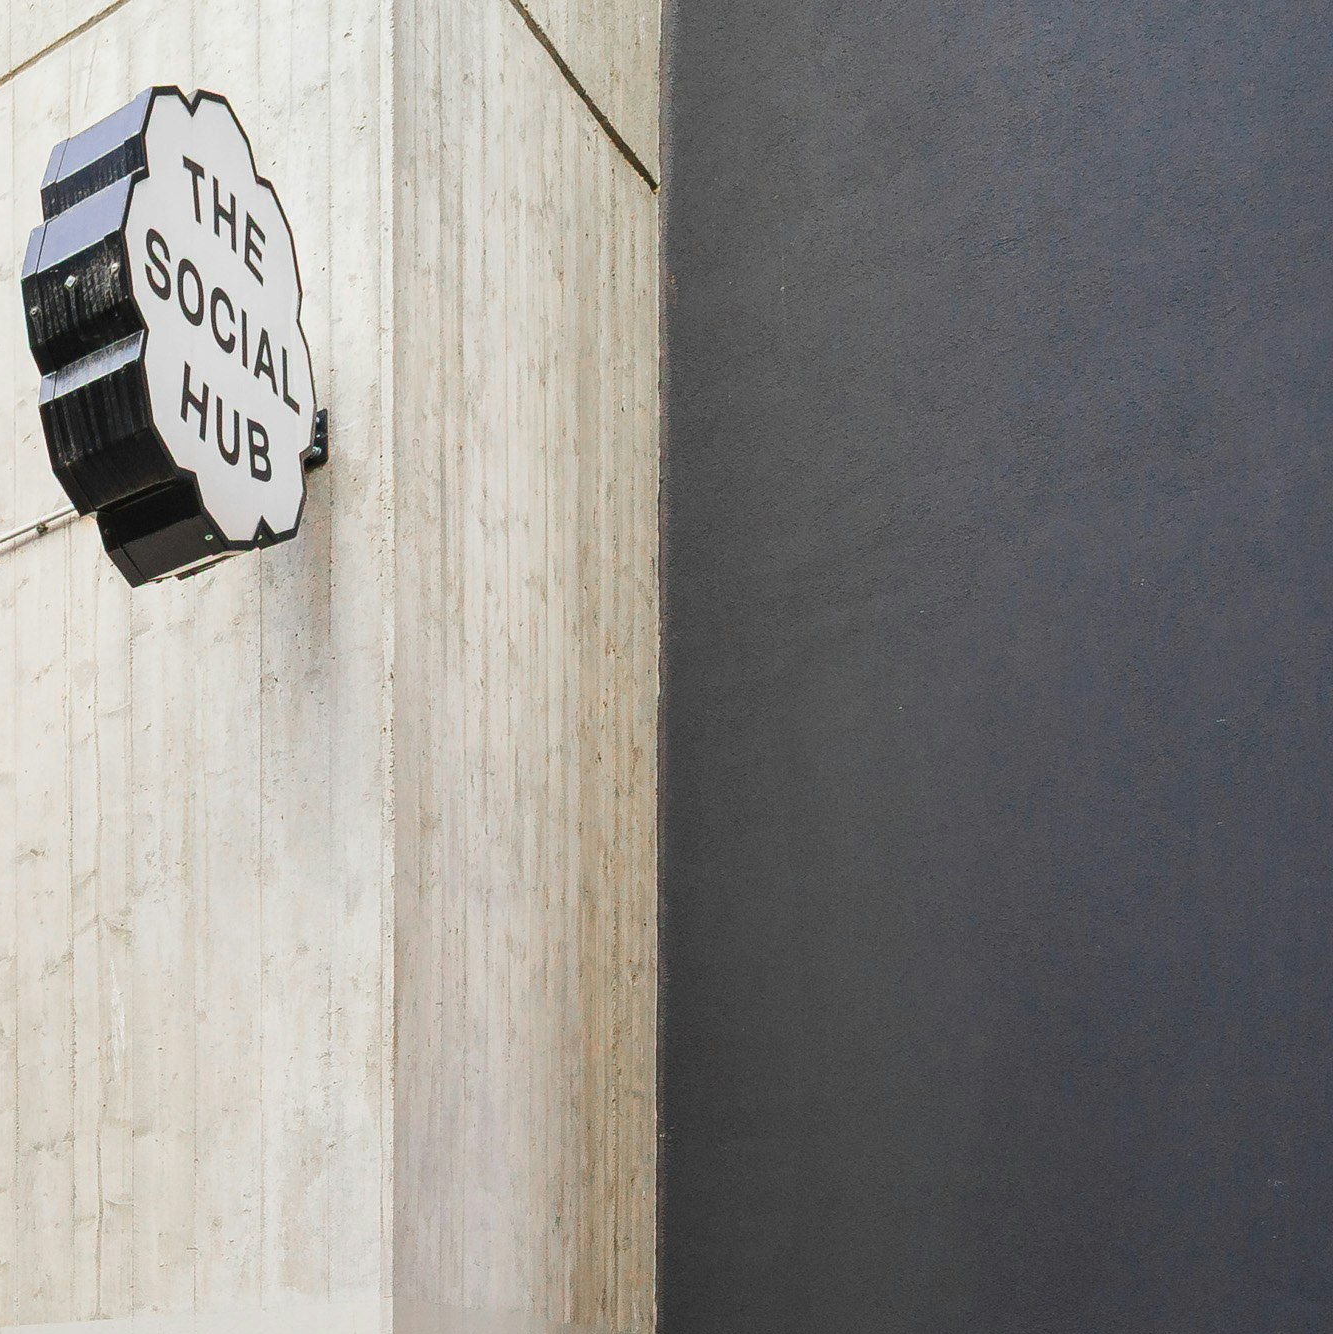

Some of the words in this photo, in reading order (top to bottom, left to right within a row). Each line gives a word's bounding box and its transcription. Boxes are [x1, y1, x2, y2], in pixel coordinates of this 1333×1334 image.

[182, 155, 267, 286] THE
[144, 228, 301, 415] SOCIAL
[181, 361, 272, 483] HUB
